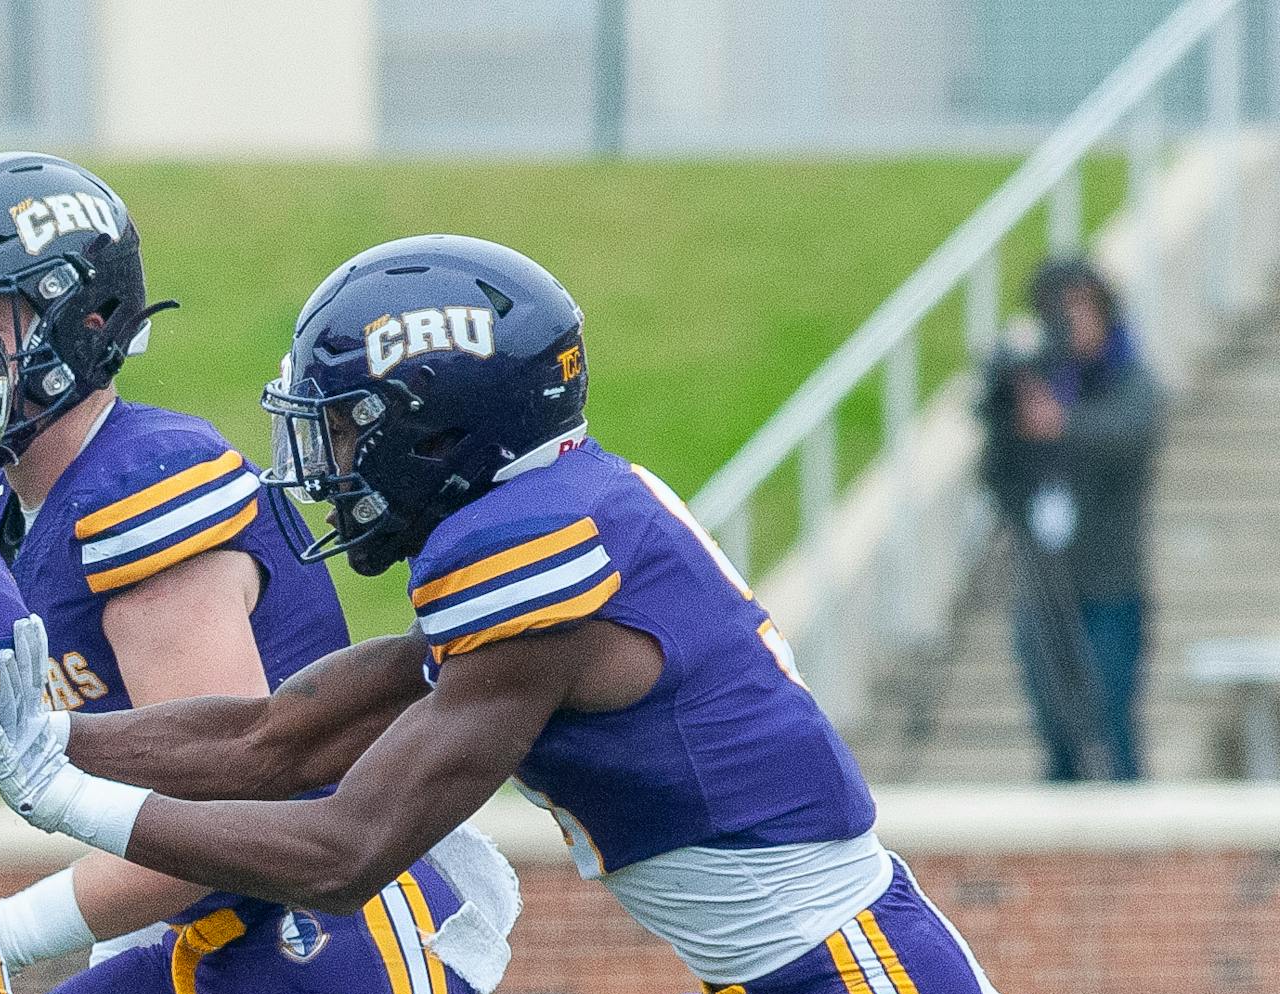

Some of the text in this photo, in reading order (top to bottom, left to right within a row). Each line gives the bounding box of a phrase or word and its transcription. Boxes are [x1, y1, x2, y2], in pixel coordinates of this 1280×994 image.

[15, 191, 121, 257] CRU
[365, 305, 497, 380] CRU
[556, 344, 581, 382] TCC
